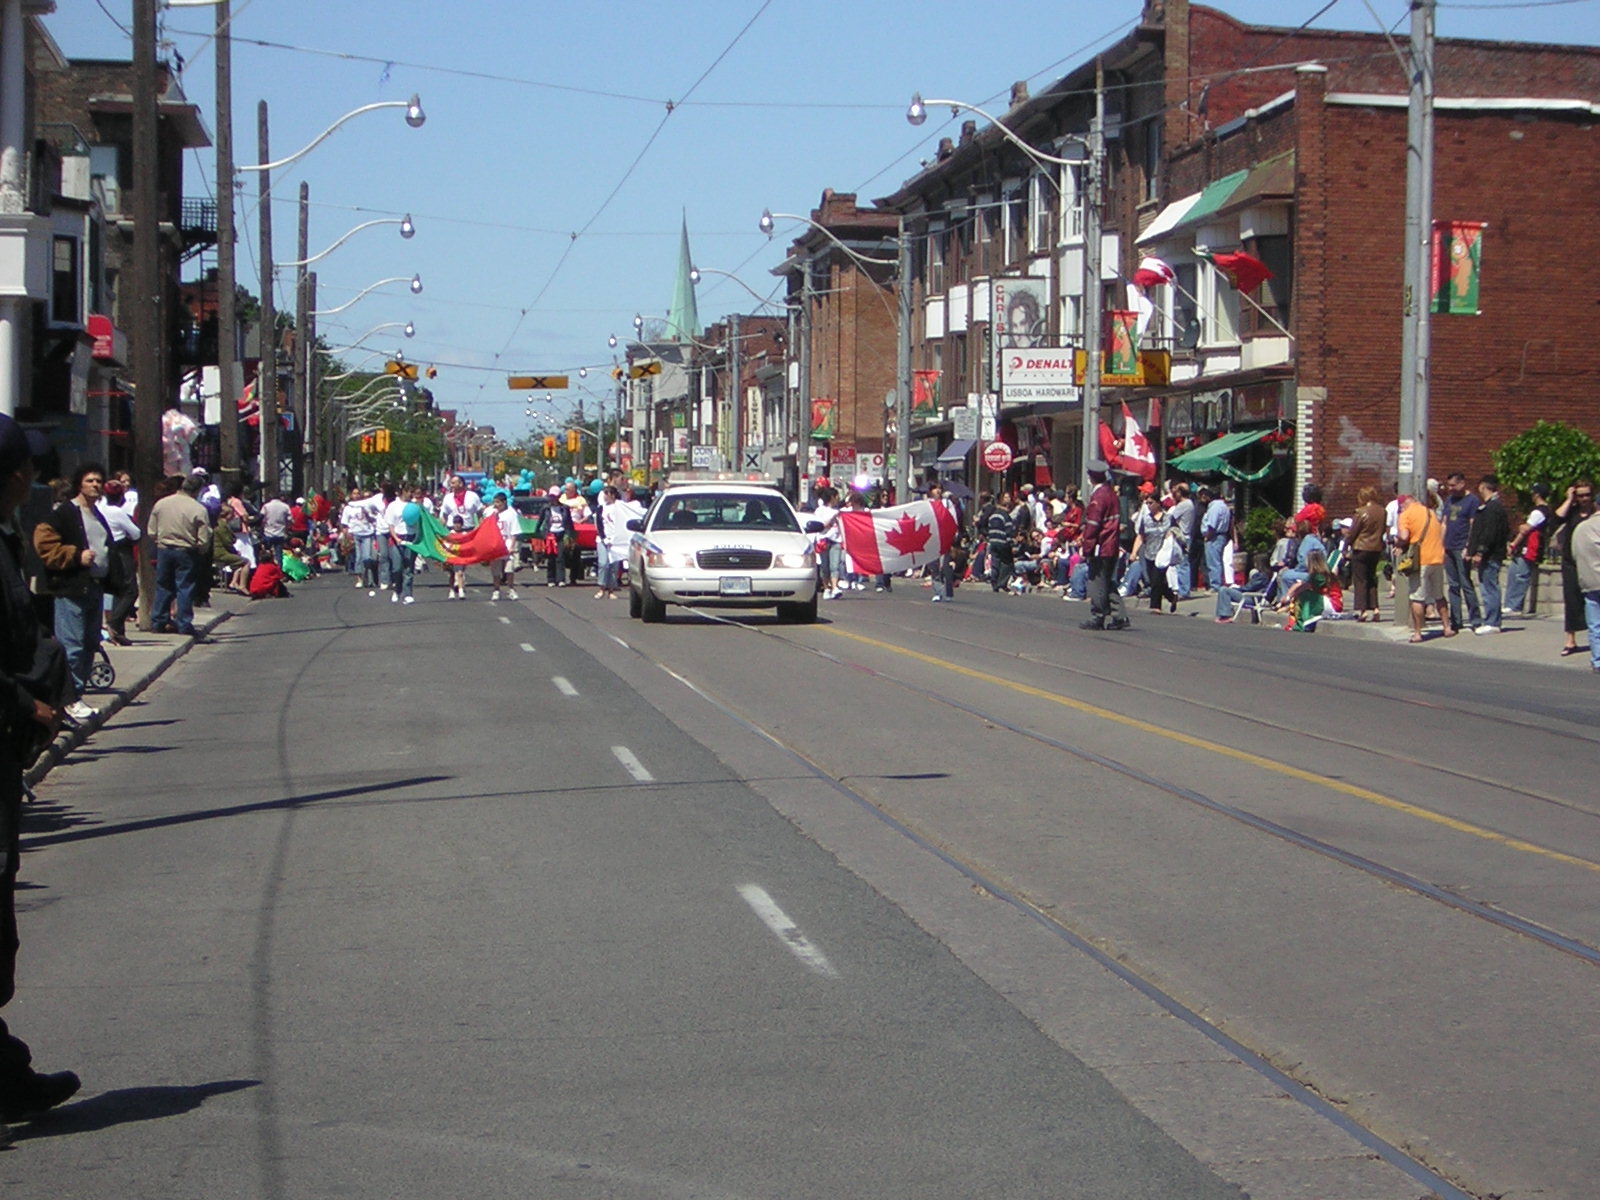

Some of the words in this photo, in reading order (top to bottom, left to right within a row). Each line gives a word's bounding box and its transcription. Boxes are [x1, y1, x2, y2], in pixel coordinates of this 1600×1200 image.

[996, 285, 1005, 334] CHRIS
[1006, 388, 1033, 397] LISBOA
[1036, 387, 1076, 397] HARDWARE
